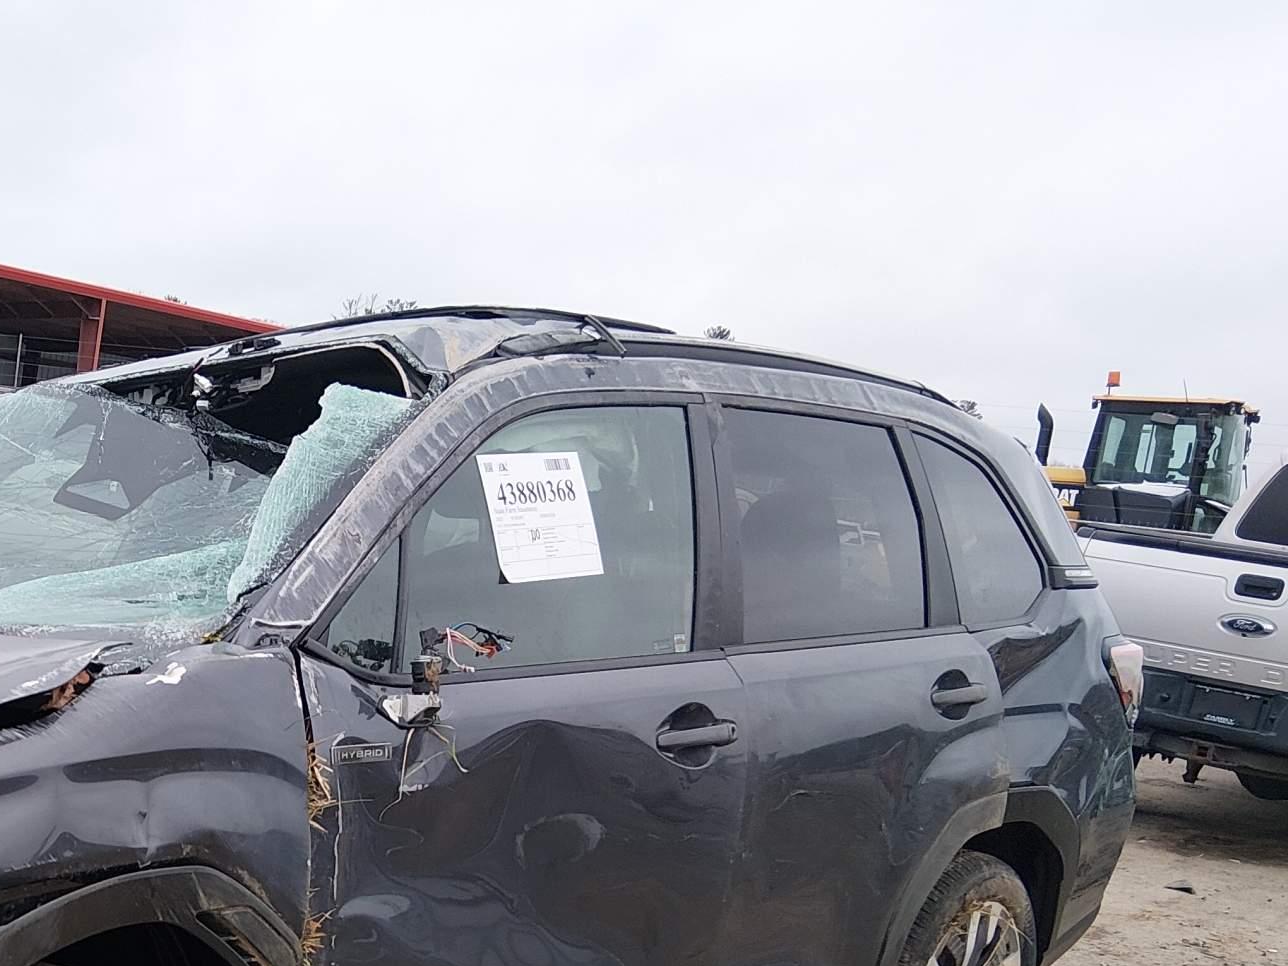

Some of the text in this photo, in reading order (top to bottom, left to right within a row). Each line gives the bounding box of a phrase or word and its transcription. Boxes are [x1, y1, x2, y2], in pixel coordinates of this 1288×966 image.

[497, 479, 577, 506] 43880368
[1233, 619, 1257, 631] Ford
[1143, 645, 1285, 686] UPER D
[341, 748, 384, 759] HYBRID
